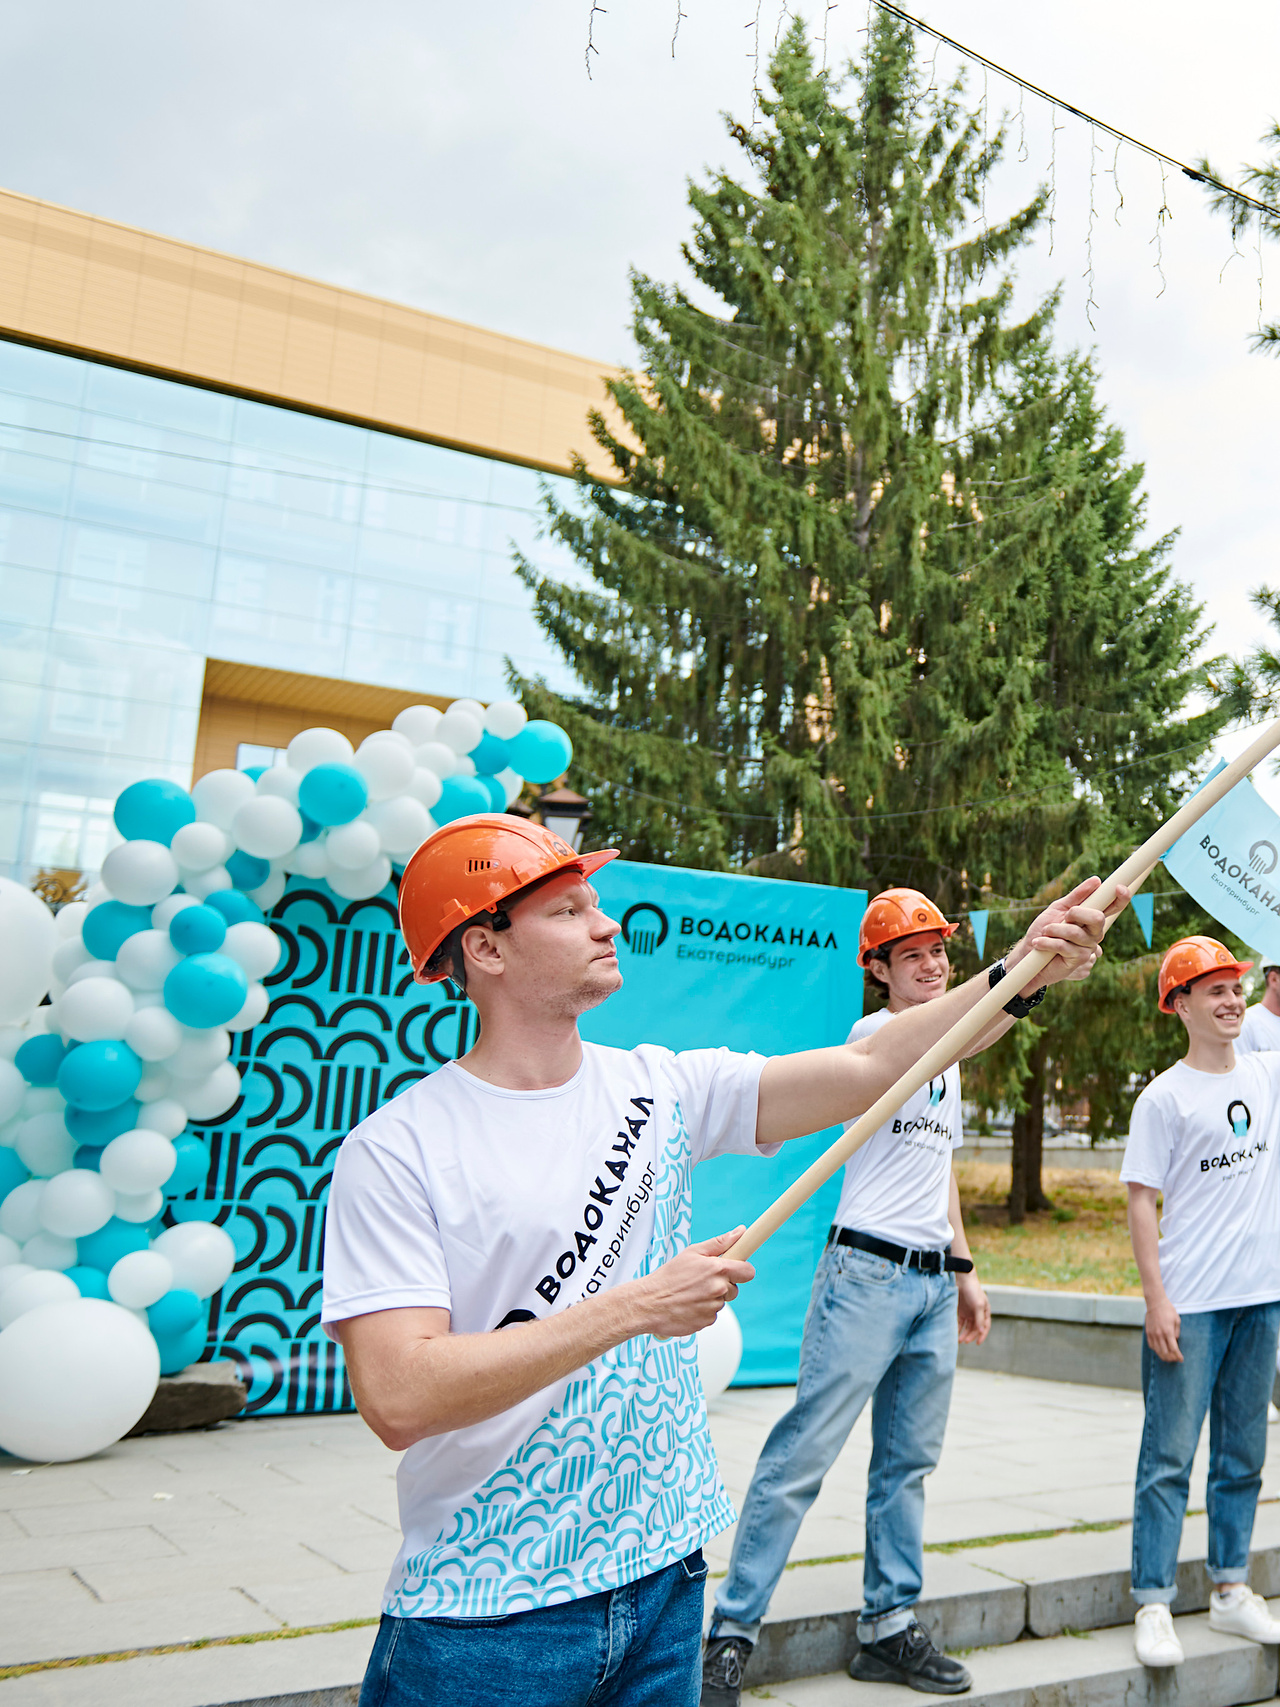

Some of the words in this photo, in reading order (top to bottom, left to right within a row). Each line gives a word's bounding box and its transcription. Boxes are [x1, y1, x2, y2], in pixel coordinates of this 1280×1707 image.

[1211, 872, 1260, 916] Екатеринбург
[680, 916, 839, 950] ВОДОКАНАЛ
[677, 944, 796, 971] Екатеринбург
[535, 1096, 655, 1305] ВОДОКАНАЛ
[566, 1161, 656, 1309] атеринбург
